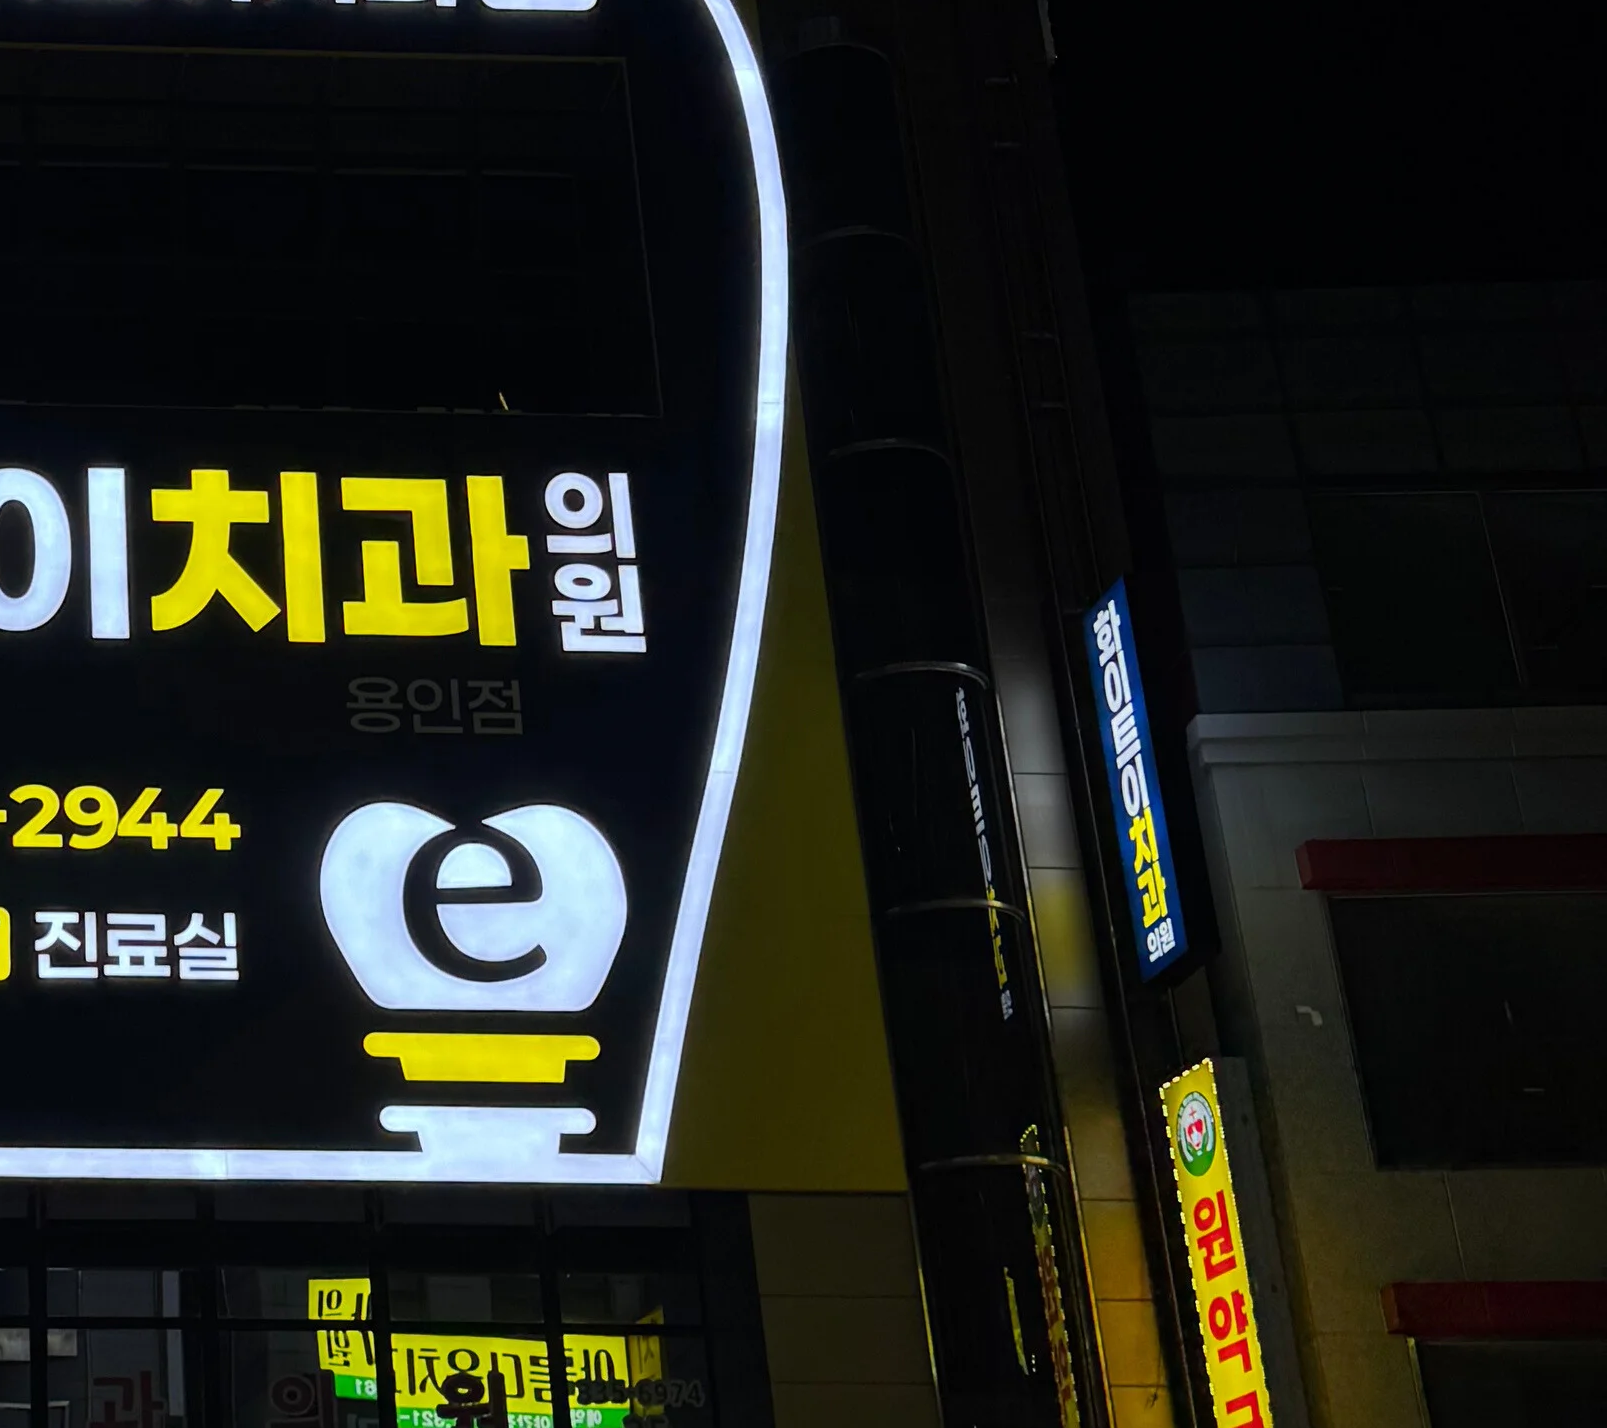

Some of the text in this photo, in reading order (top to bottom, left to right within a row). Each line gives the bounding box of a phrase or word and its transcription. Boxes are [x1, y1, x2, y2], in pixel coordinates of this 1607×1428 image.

[543, 471, 648, 655] 의원
[344, 676, 524, 738] 용인점
[1094, 599, 1177, 964] 화이트이치과 의원
[31, 911, 241, 981] 진료실
